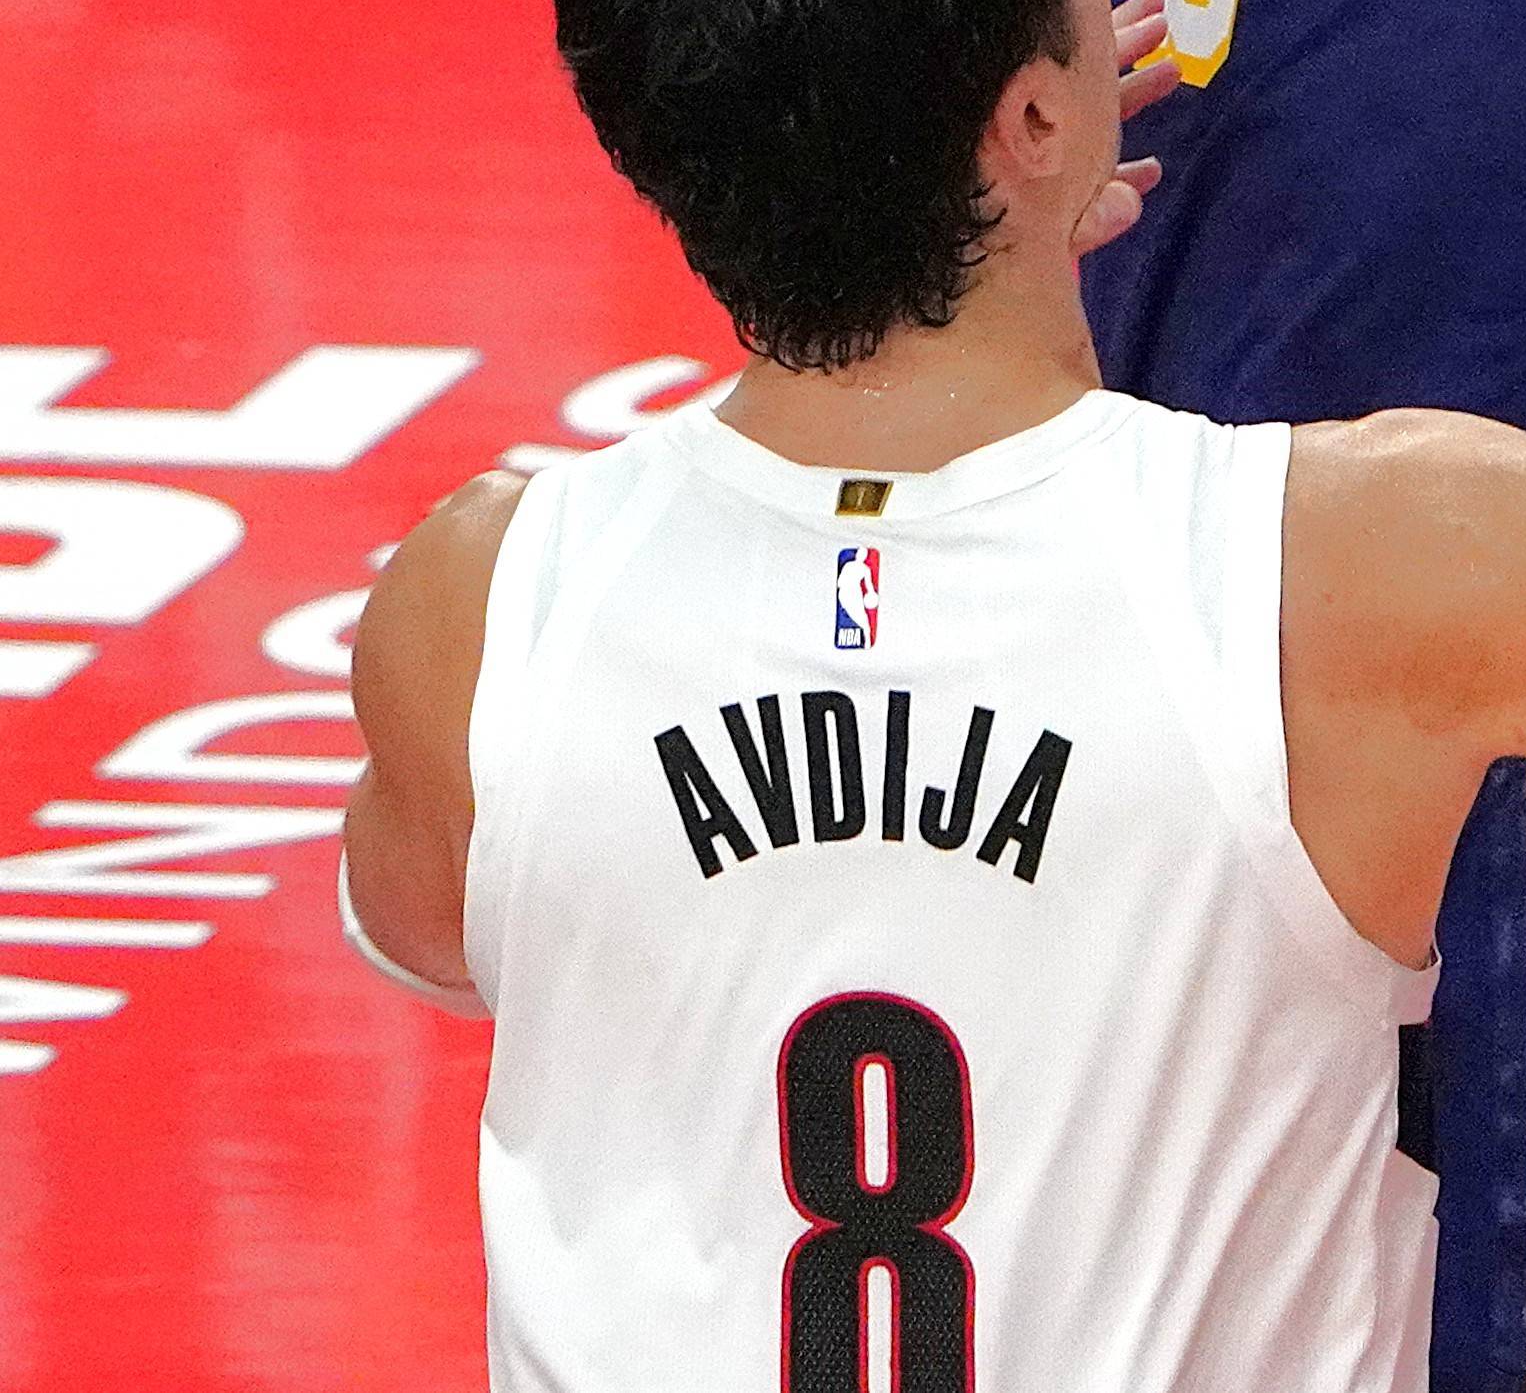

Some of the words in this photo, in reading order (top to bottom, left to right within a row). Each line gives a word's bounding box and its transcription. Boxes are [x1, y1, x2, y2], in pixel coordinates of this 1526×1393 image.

[838, 627, 862, 647] NBA
[654, 689, 1073, 884] AVDIJA
[777, 990, 976, 1393] 8
